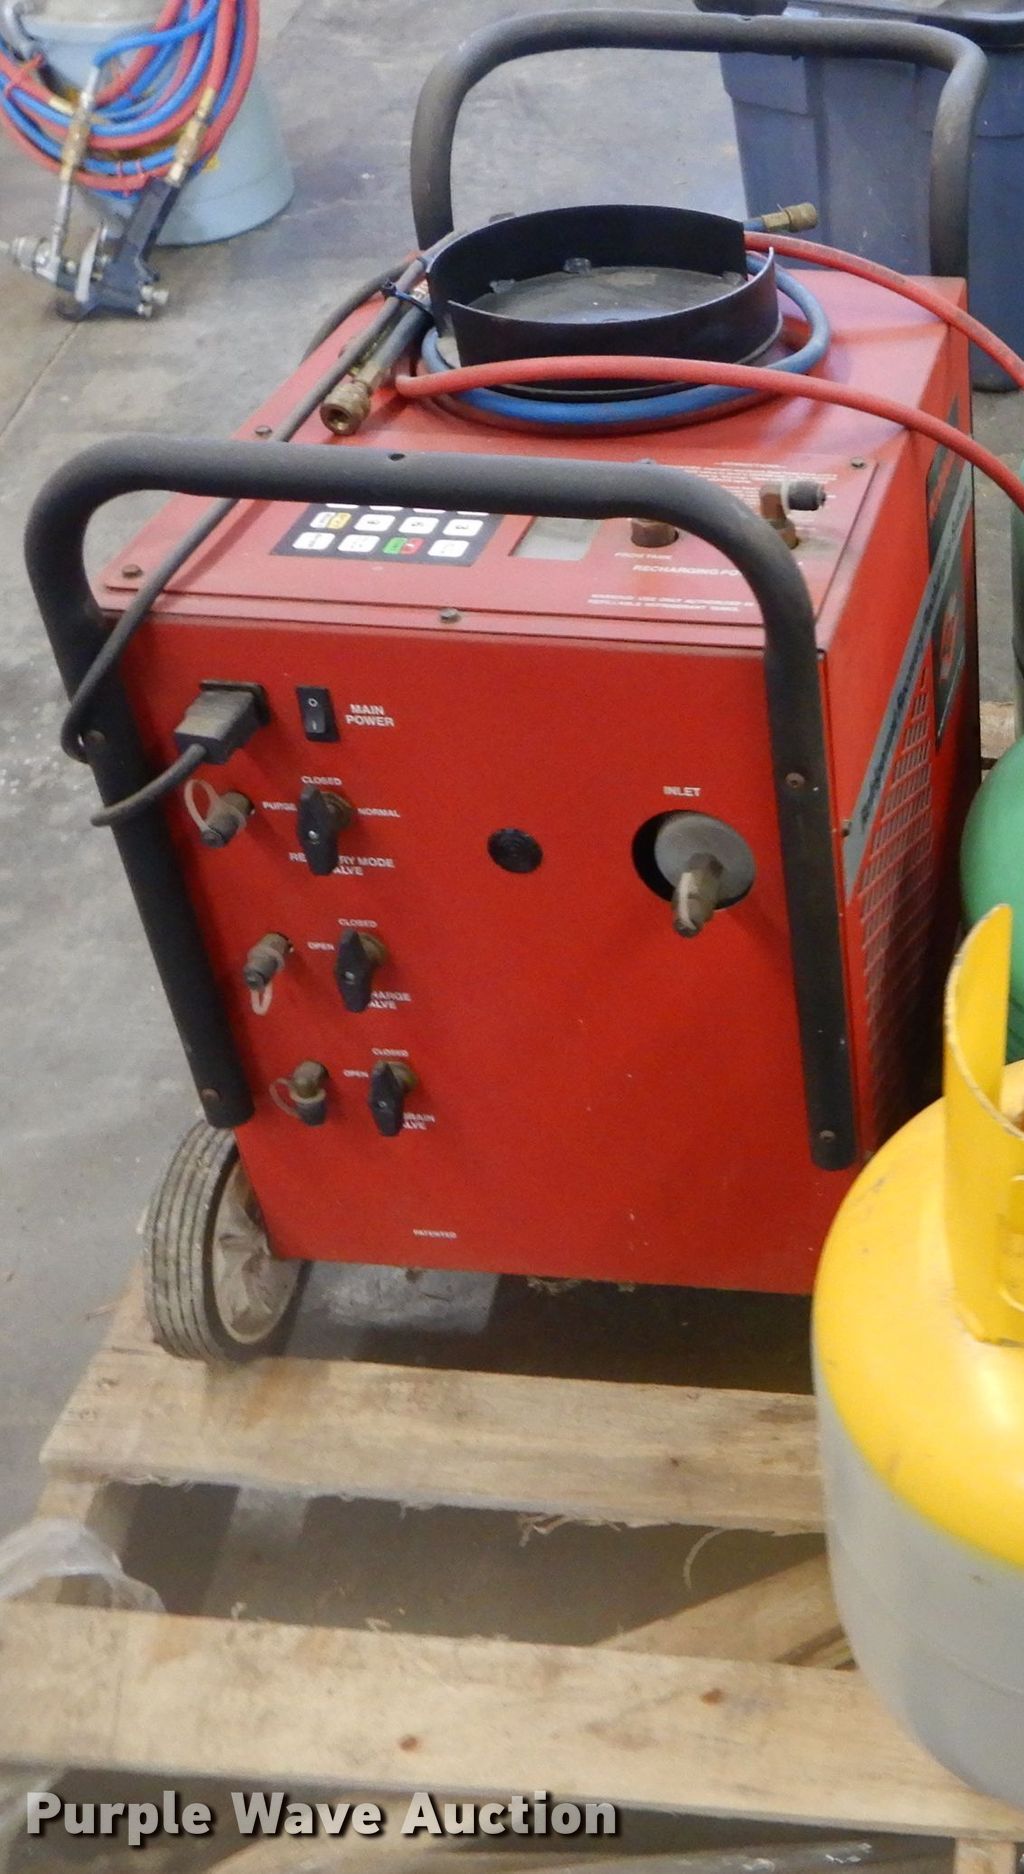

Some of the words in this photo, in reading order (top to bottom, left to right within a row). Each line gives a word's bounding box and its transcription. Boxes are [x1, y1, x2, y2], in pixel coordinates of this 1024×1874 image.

[632, 564, 719, 576] RECHARGING
[720, 569, 742, 577] PO
[350, 704, 384, 716] MAIN
[346, 714, 395, 727] POWER
[301, 775, 342, 786] CLOSED
[663, 785, 701, 797] INLET
[357, 807, 400, 818] NORMAL
[357, 856, 395, 868] MODE
[332, 866, 364, 876] ALVE
[338, 918, 378, 929] CLOSED
[307, 941, 335, 951] OPEN
[370, 991, 411, 1001] HARGE
[367, 1000, 397, 1009] ALVE
[371, 1047, 409, 1057] CLOSED
[343, 1069, 369, 1078] OPEN
